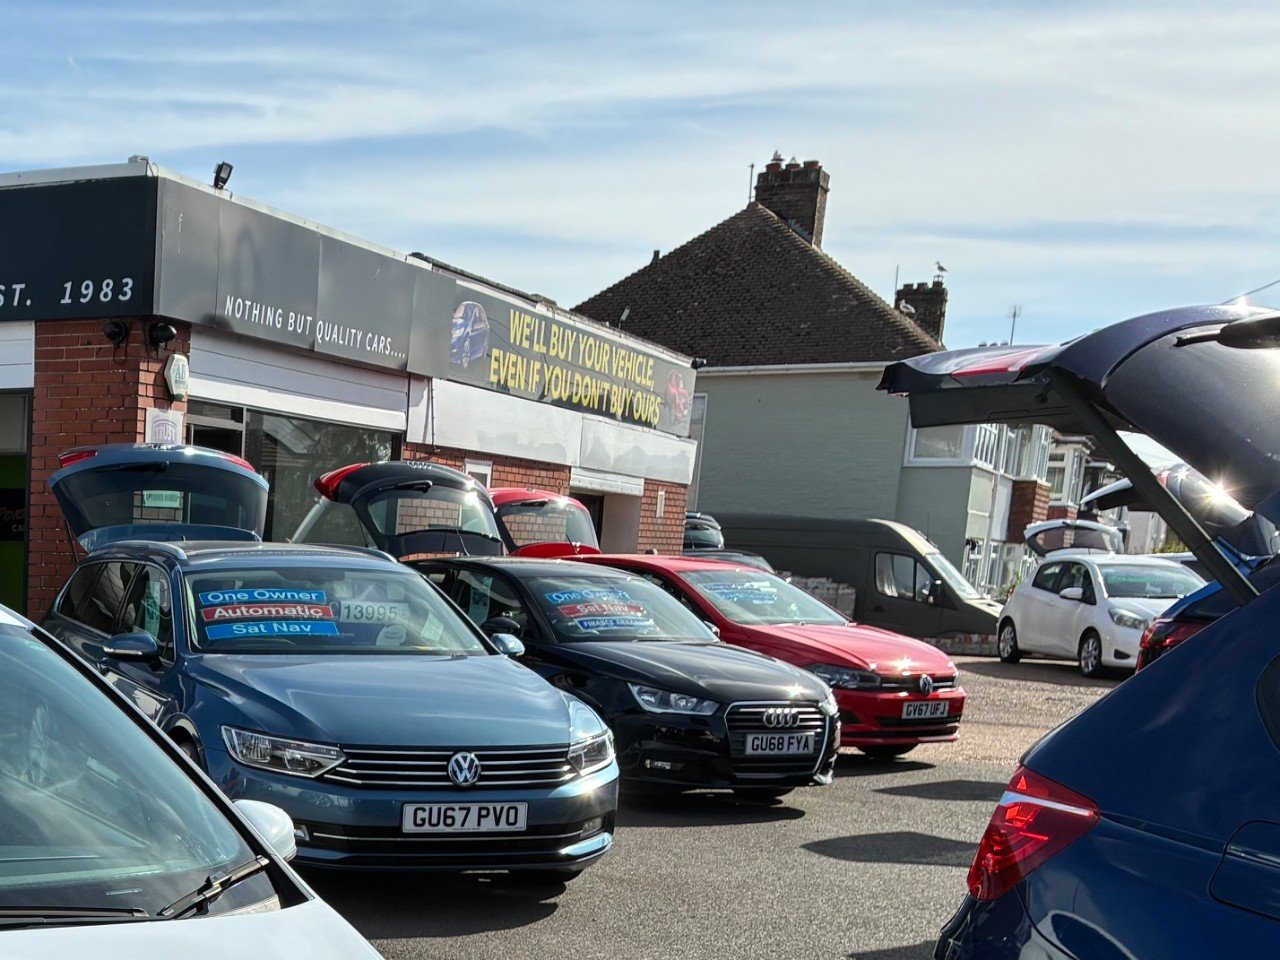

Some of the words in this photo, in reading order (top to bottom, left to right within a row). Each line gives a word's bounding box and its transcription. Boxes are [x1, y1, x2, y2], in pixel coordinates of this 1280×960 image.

[60, 277, 134, 304] 1983
[224, 295, 282, 328] NOTHING
[288, 310, 312, 335] BUT
[316, 319, 363, 349] QUALITY
[510, 309, 546, 353] WE'LL
[550, 325, 576, 360] BUY
[579, 330, 609, 373] YOUR
[490, 348, 526, 389] EVEN
[528, 360, 540, 393] IF
[544, 363, 571, 401] YOU
[573, 374, 610, 411] DON'T
[610, 385, 635, 416] BUY
[634, 391, 661, 425] OURS
[207, 591, 248, 601] One
[254, 589, 319, 601] Owner
[553, 591, 581, 601] One
[212, 604, 323, 619] Automatic
[344, 604, 398, 620] 13995
[577, 604, 602, 613] Sat
[232, 623, 268, 634] Sat
[274, 621, 312, 633] Nav
[751, 736, 785, 751] GU68
[787, 735, 810, 750] FYA
[413, 806, 471, 828] GU67
[477, 805, 519, 827] PVO
